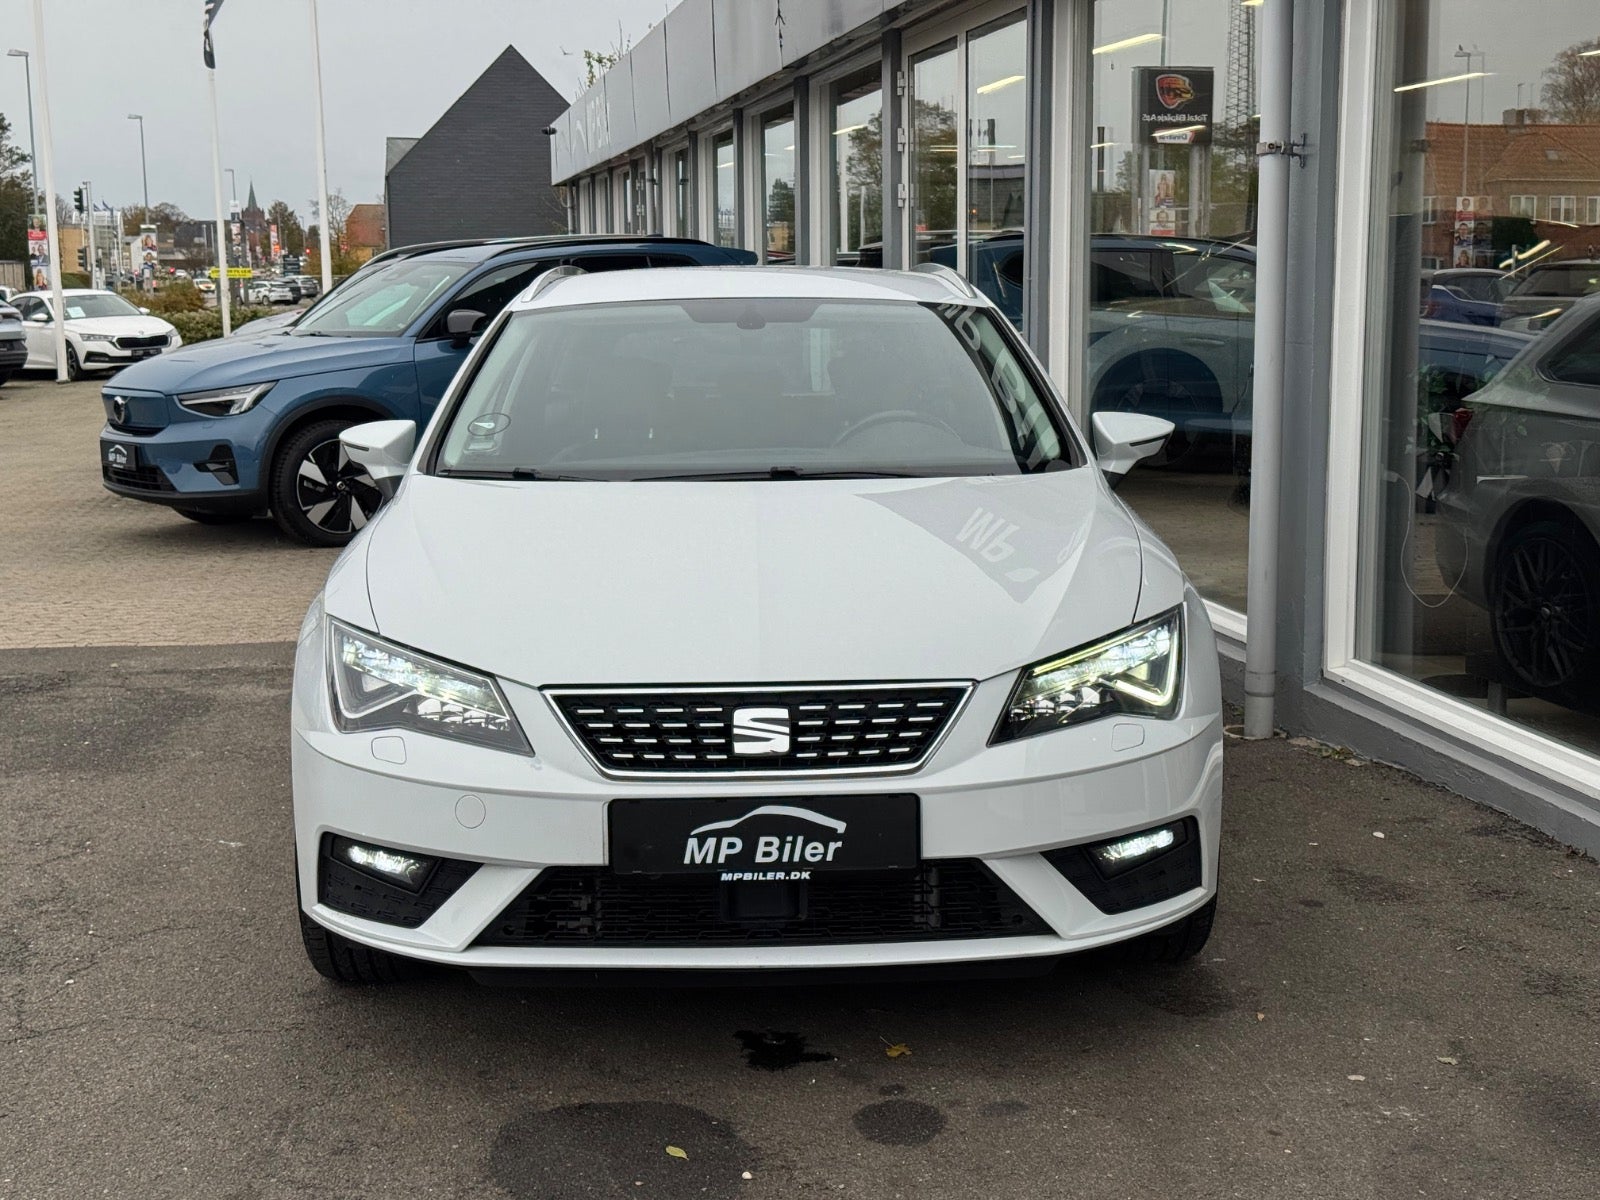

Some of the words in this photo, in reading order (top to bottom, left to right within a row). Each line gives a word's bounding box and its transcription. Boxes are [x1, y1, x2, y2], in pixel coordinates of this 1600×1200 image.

[683, 836, 742, 864] MP
[755, 835, 843, 863] Biler
[720, 870, 811, 881] MPBILER.DK
